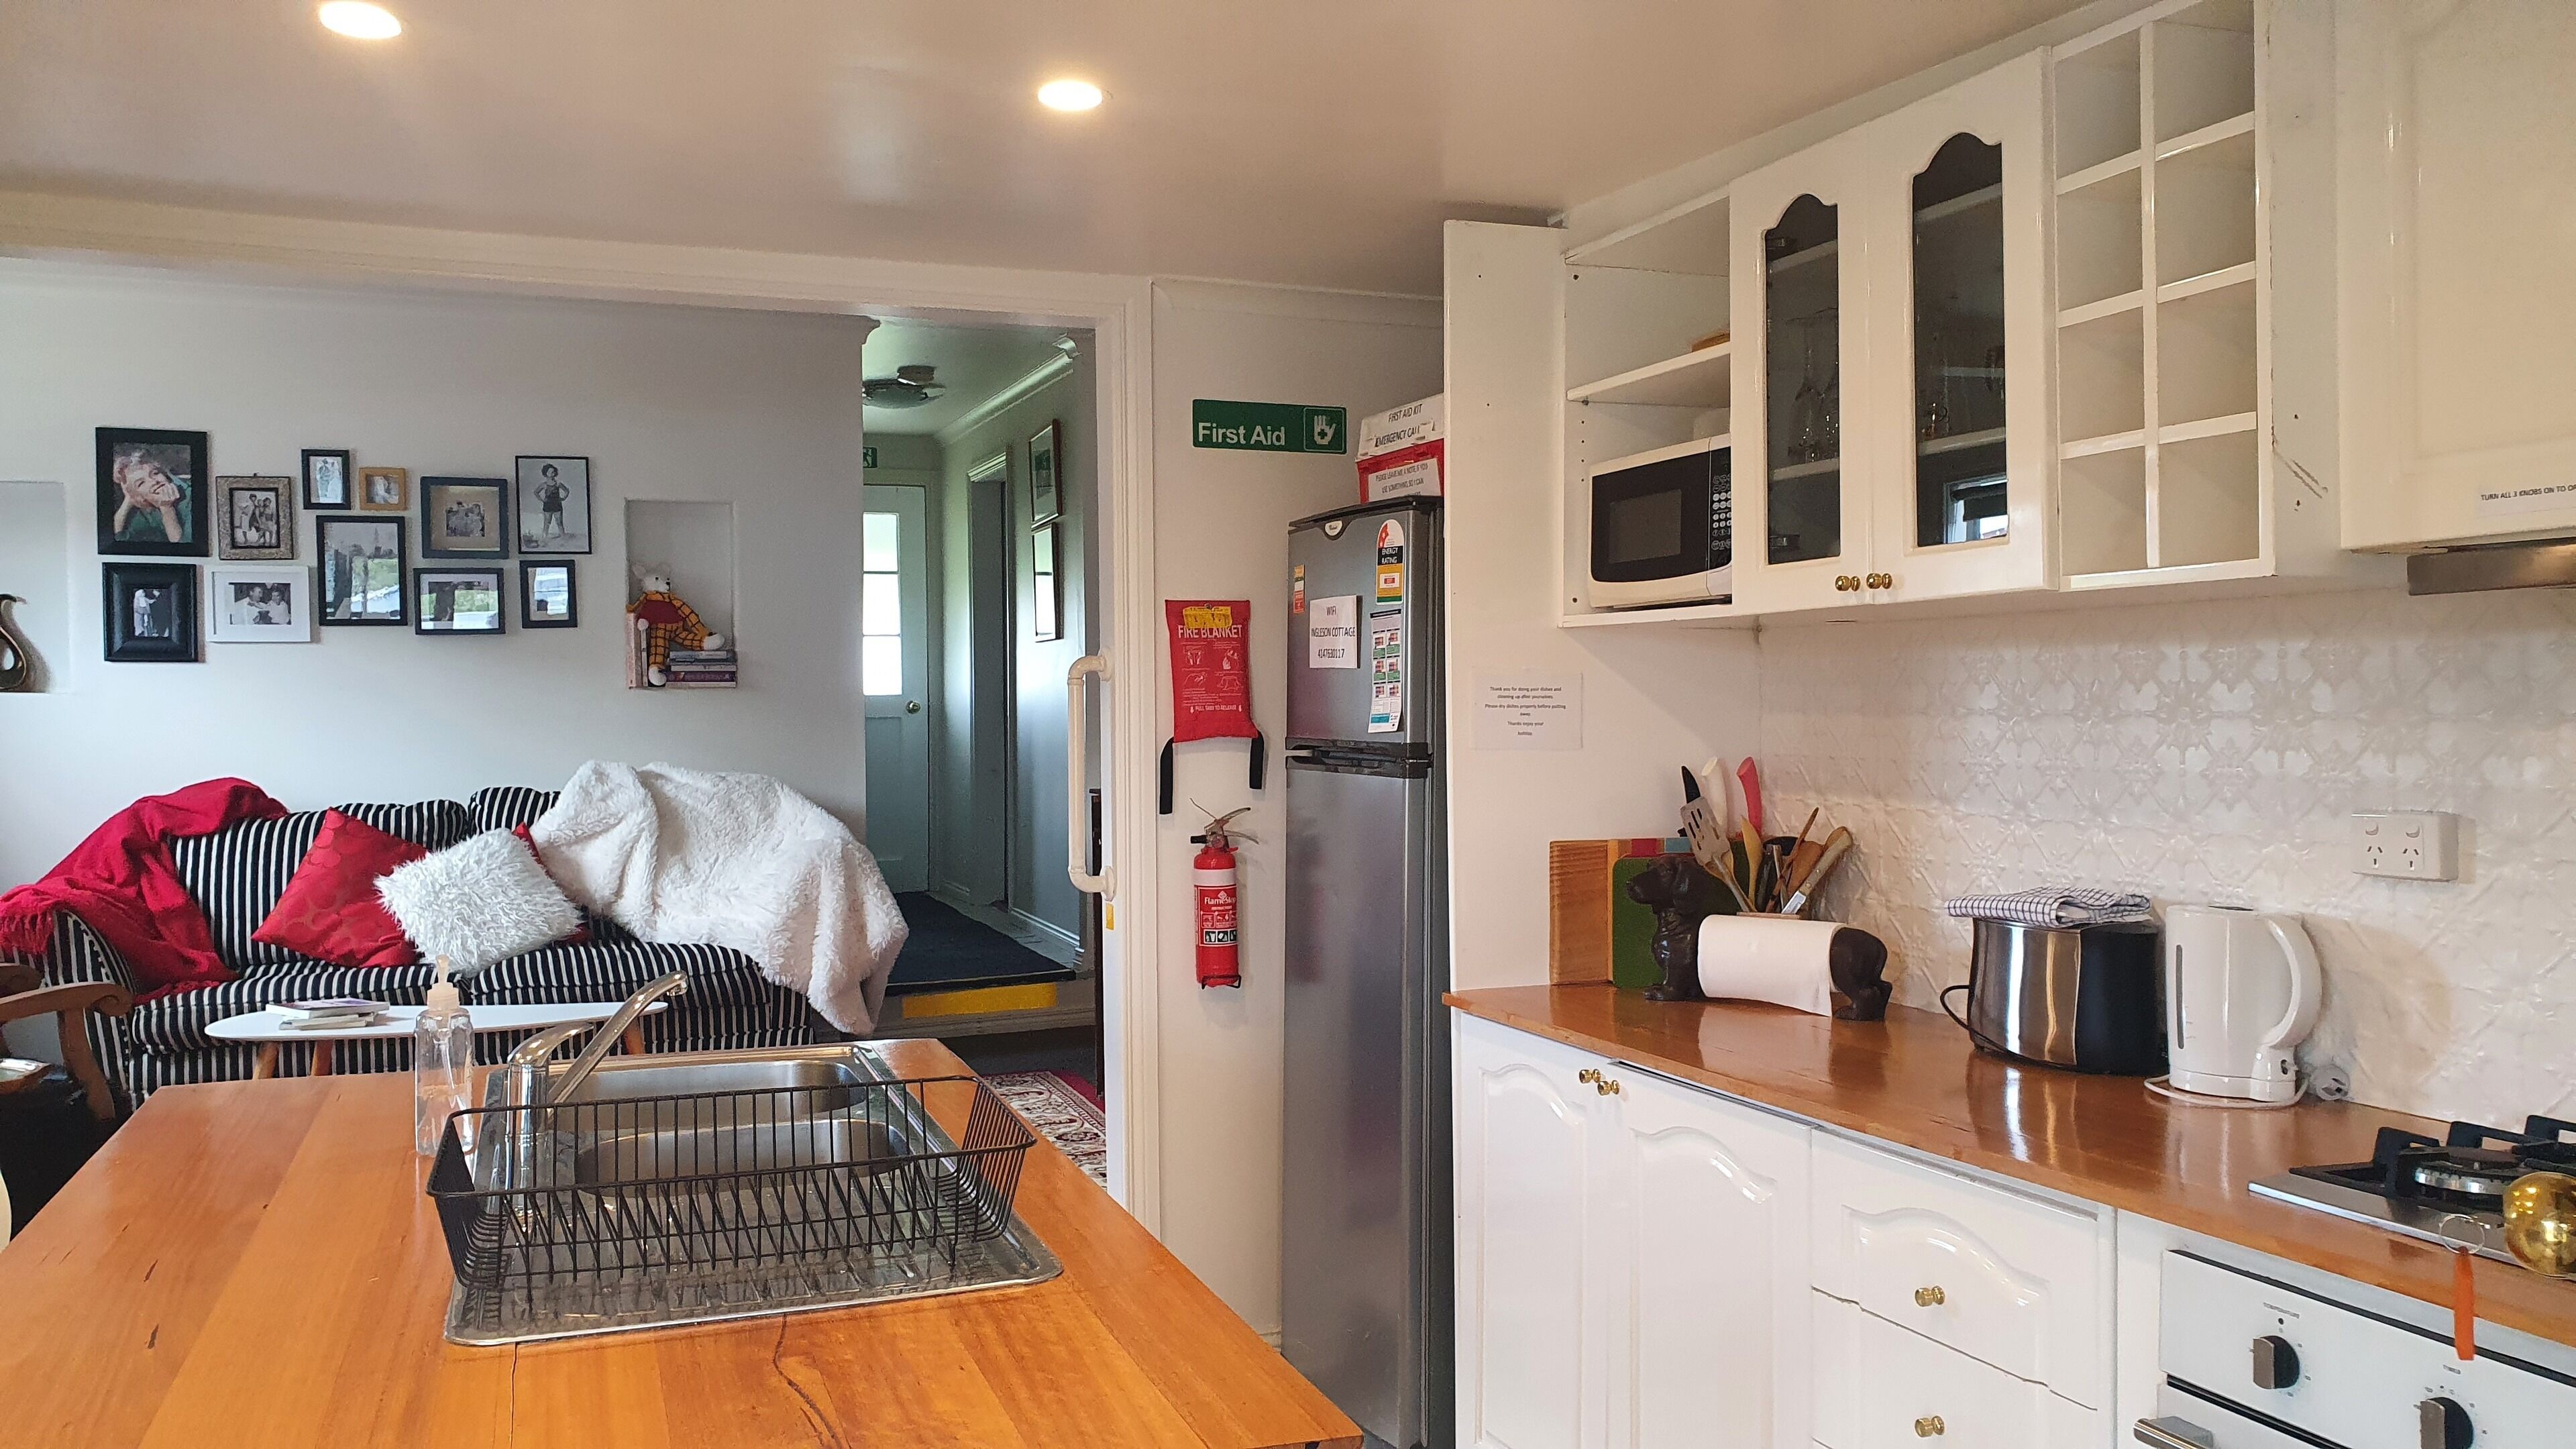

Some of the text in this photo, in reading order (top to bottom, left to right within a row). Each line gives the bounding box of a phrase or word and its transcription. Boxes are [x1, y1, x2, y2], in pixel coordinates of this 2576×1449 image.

[1389, 403, 1423, 423] FIRST AID KIT
[1198, 422, 1285, 446] First Aid
[1375, 430, 1407, 447] EMERGENCY
[2519, 488, 2542, 496] KNOBS
[1382, 547, 1399, 555] ENERGY
[1382, 556, 1397, 564] RATING
[1178, 625, 1242, 639] FIRE BLANKET
[1332, 627, 1356, 637] COTTAGE
